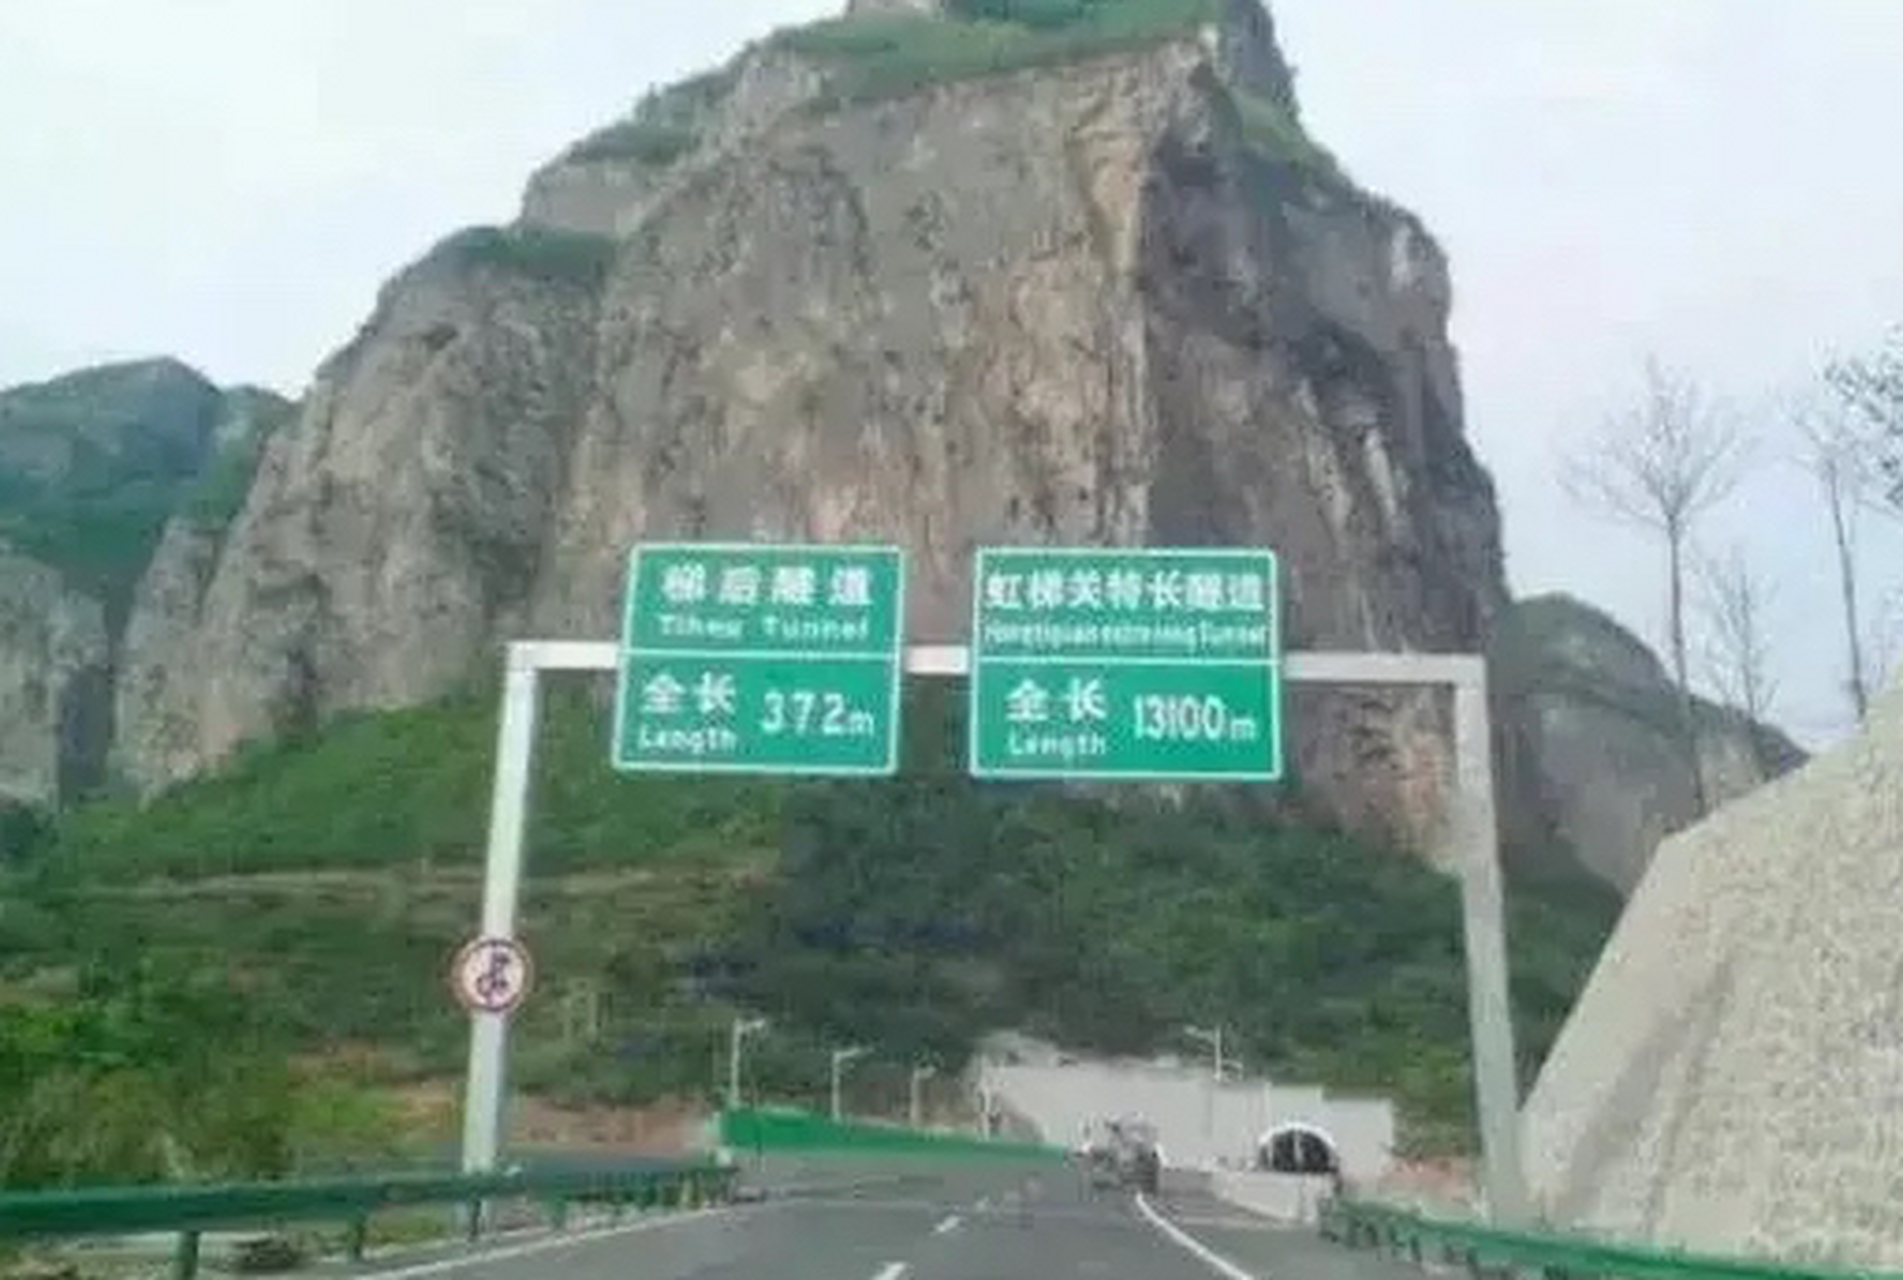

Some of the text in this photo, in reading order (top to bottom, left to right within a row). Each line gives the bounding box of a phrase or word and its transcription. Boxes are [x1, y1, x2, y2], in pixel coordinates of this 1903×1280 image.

[641, 672, 736, 715] 全长
[1005, 677, 1107, 722] 全长
[638, 724, 737, 753] Length
[1007, 731, 1105, 758] Length
